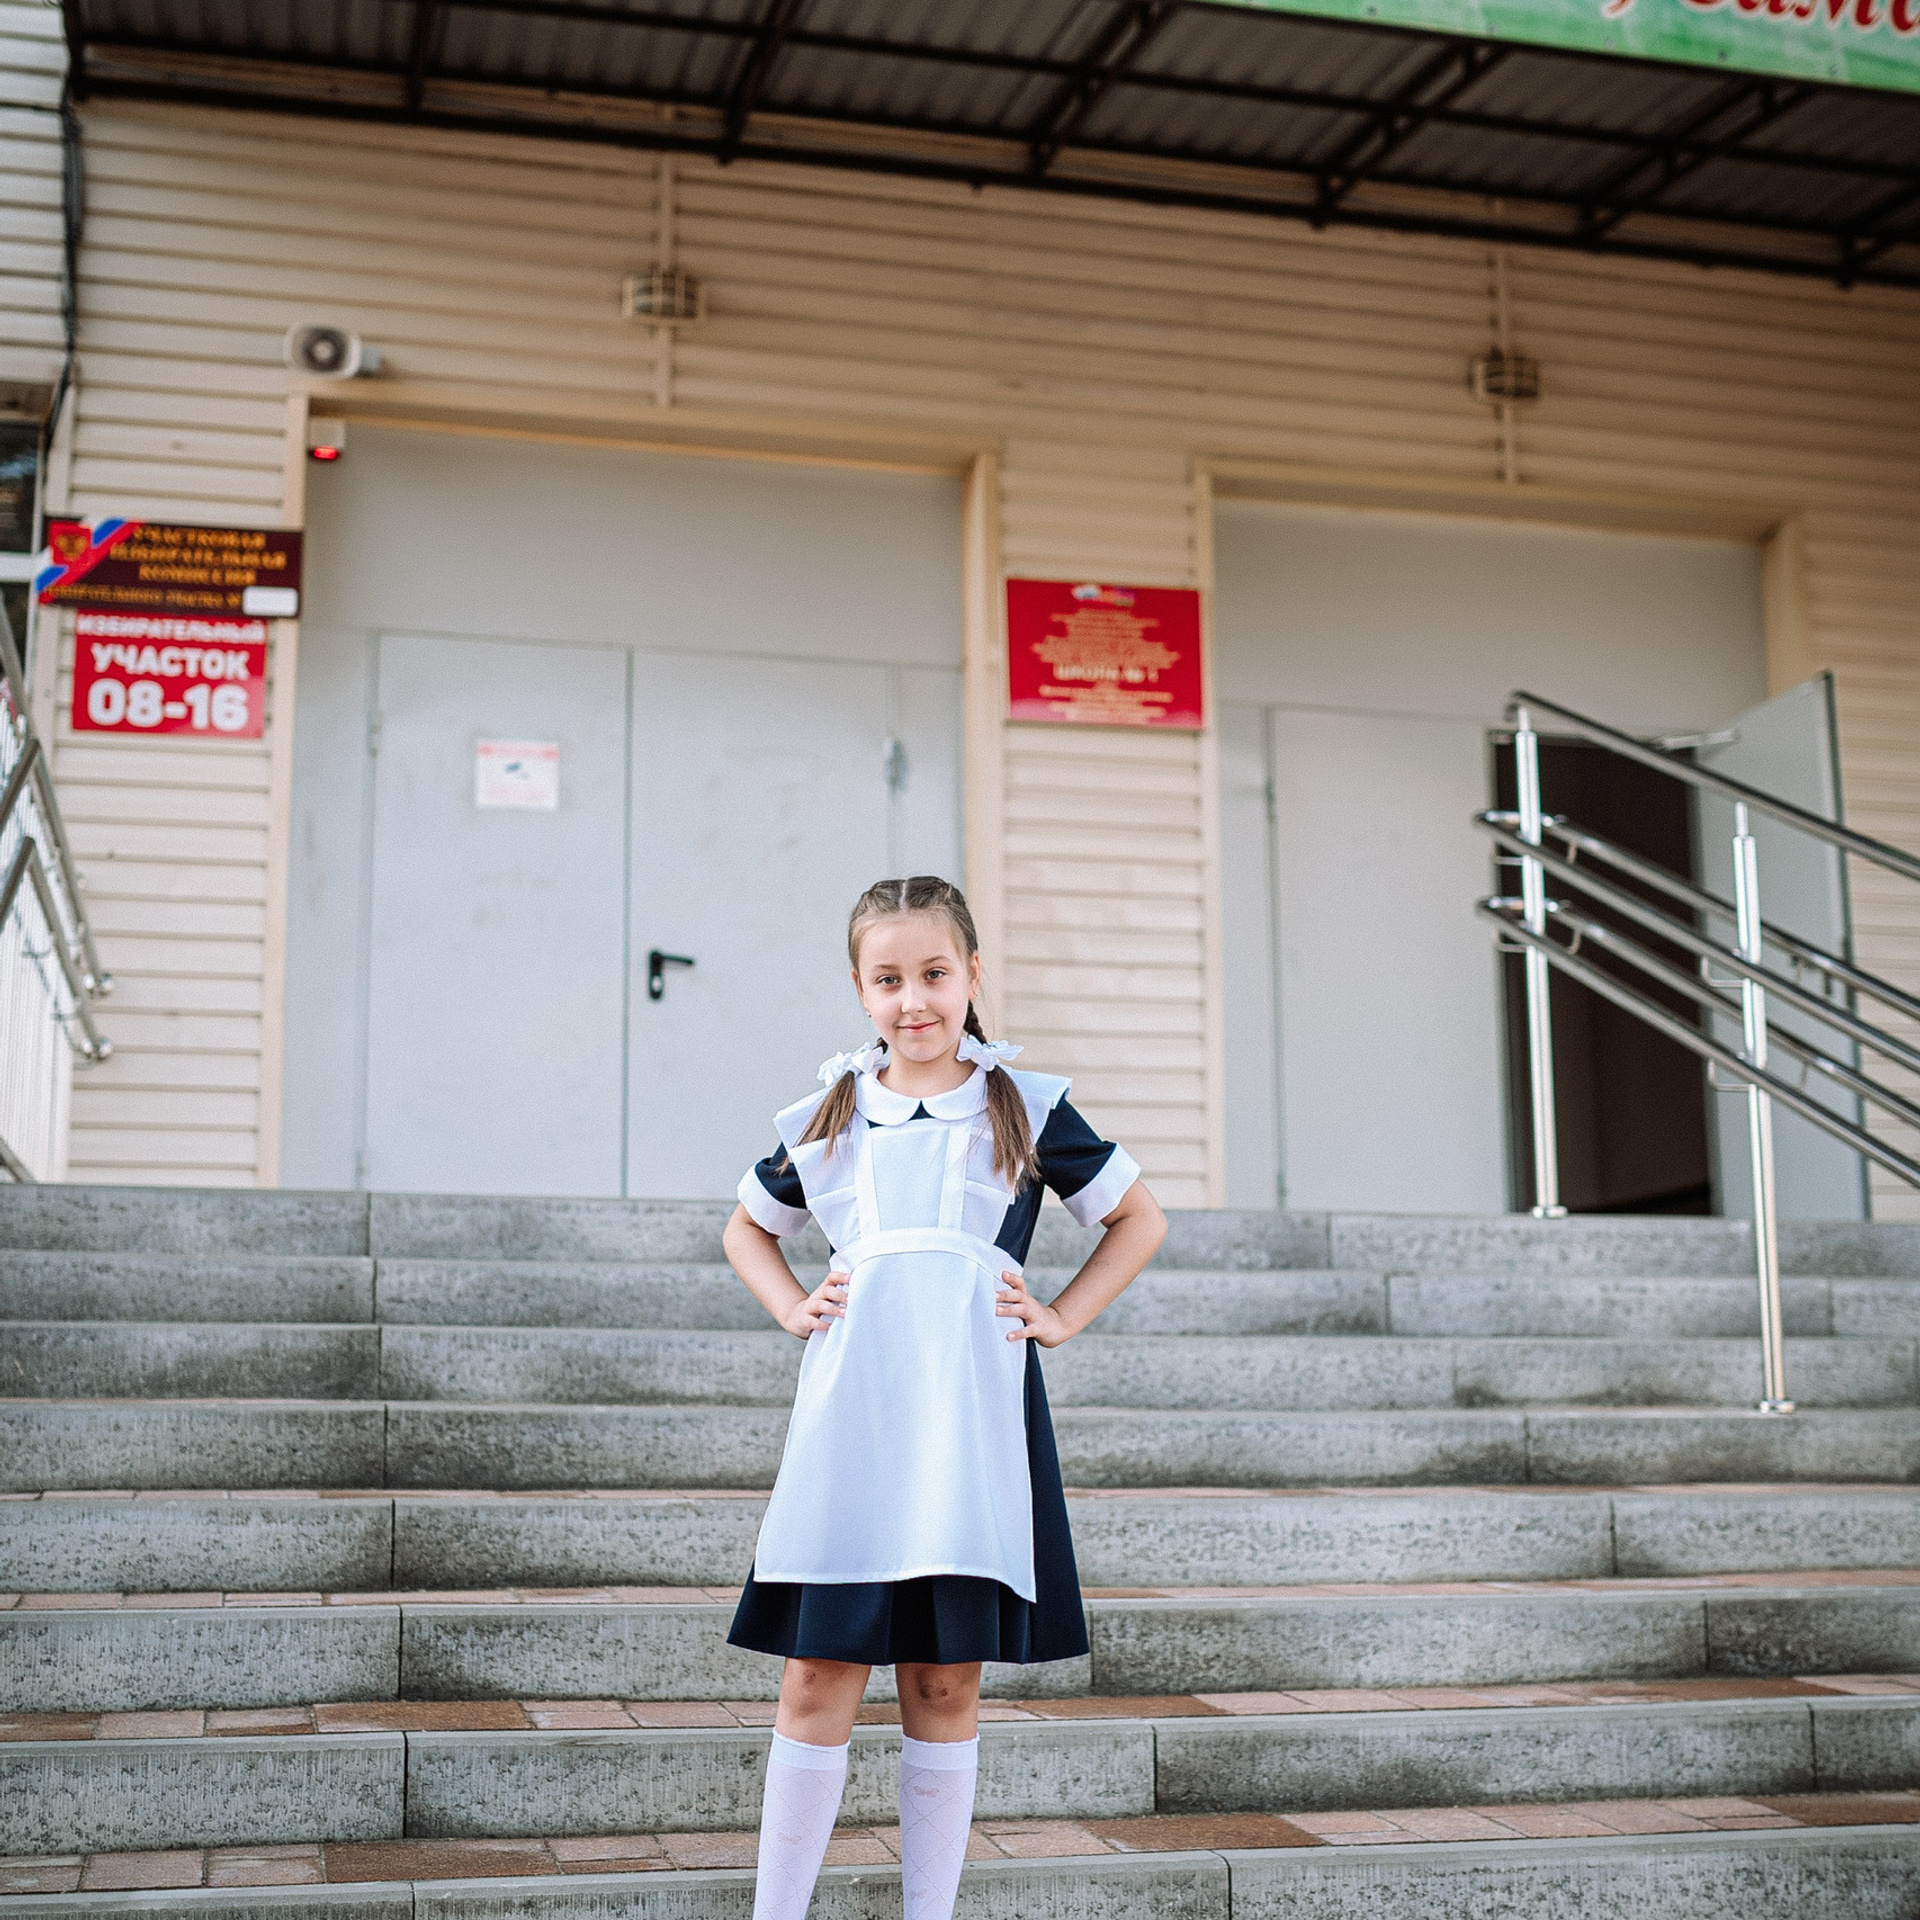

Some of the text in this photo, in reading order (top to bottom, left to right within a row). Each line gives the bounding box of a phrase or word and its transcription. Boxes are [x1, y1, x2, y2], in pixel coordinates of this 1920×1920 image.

[77, 613, 266, 645] ИЗБИРАТЕЛЬНЫЙ
[91, 642, 250, 681] УЧАСТОК
[87, 678, 250, 732] 08-16
